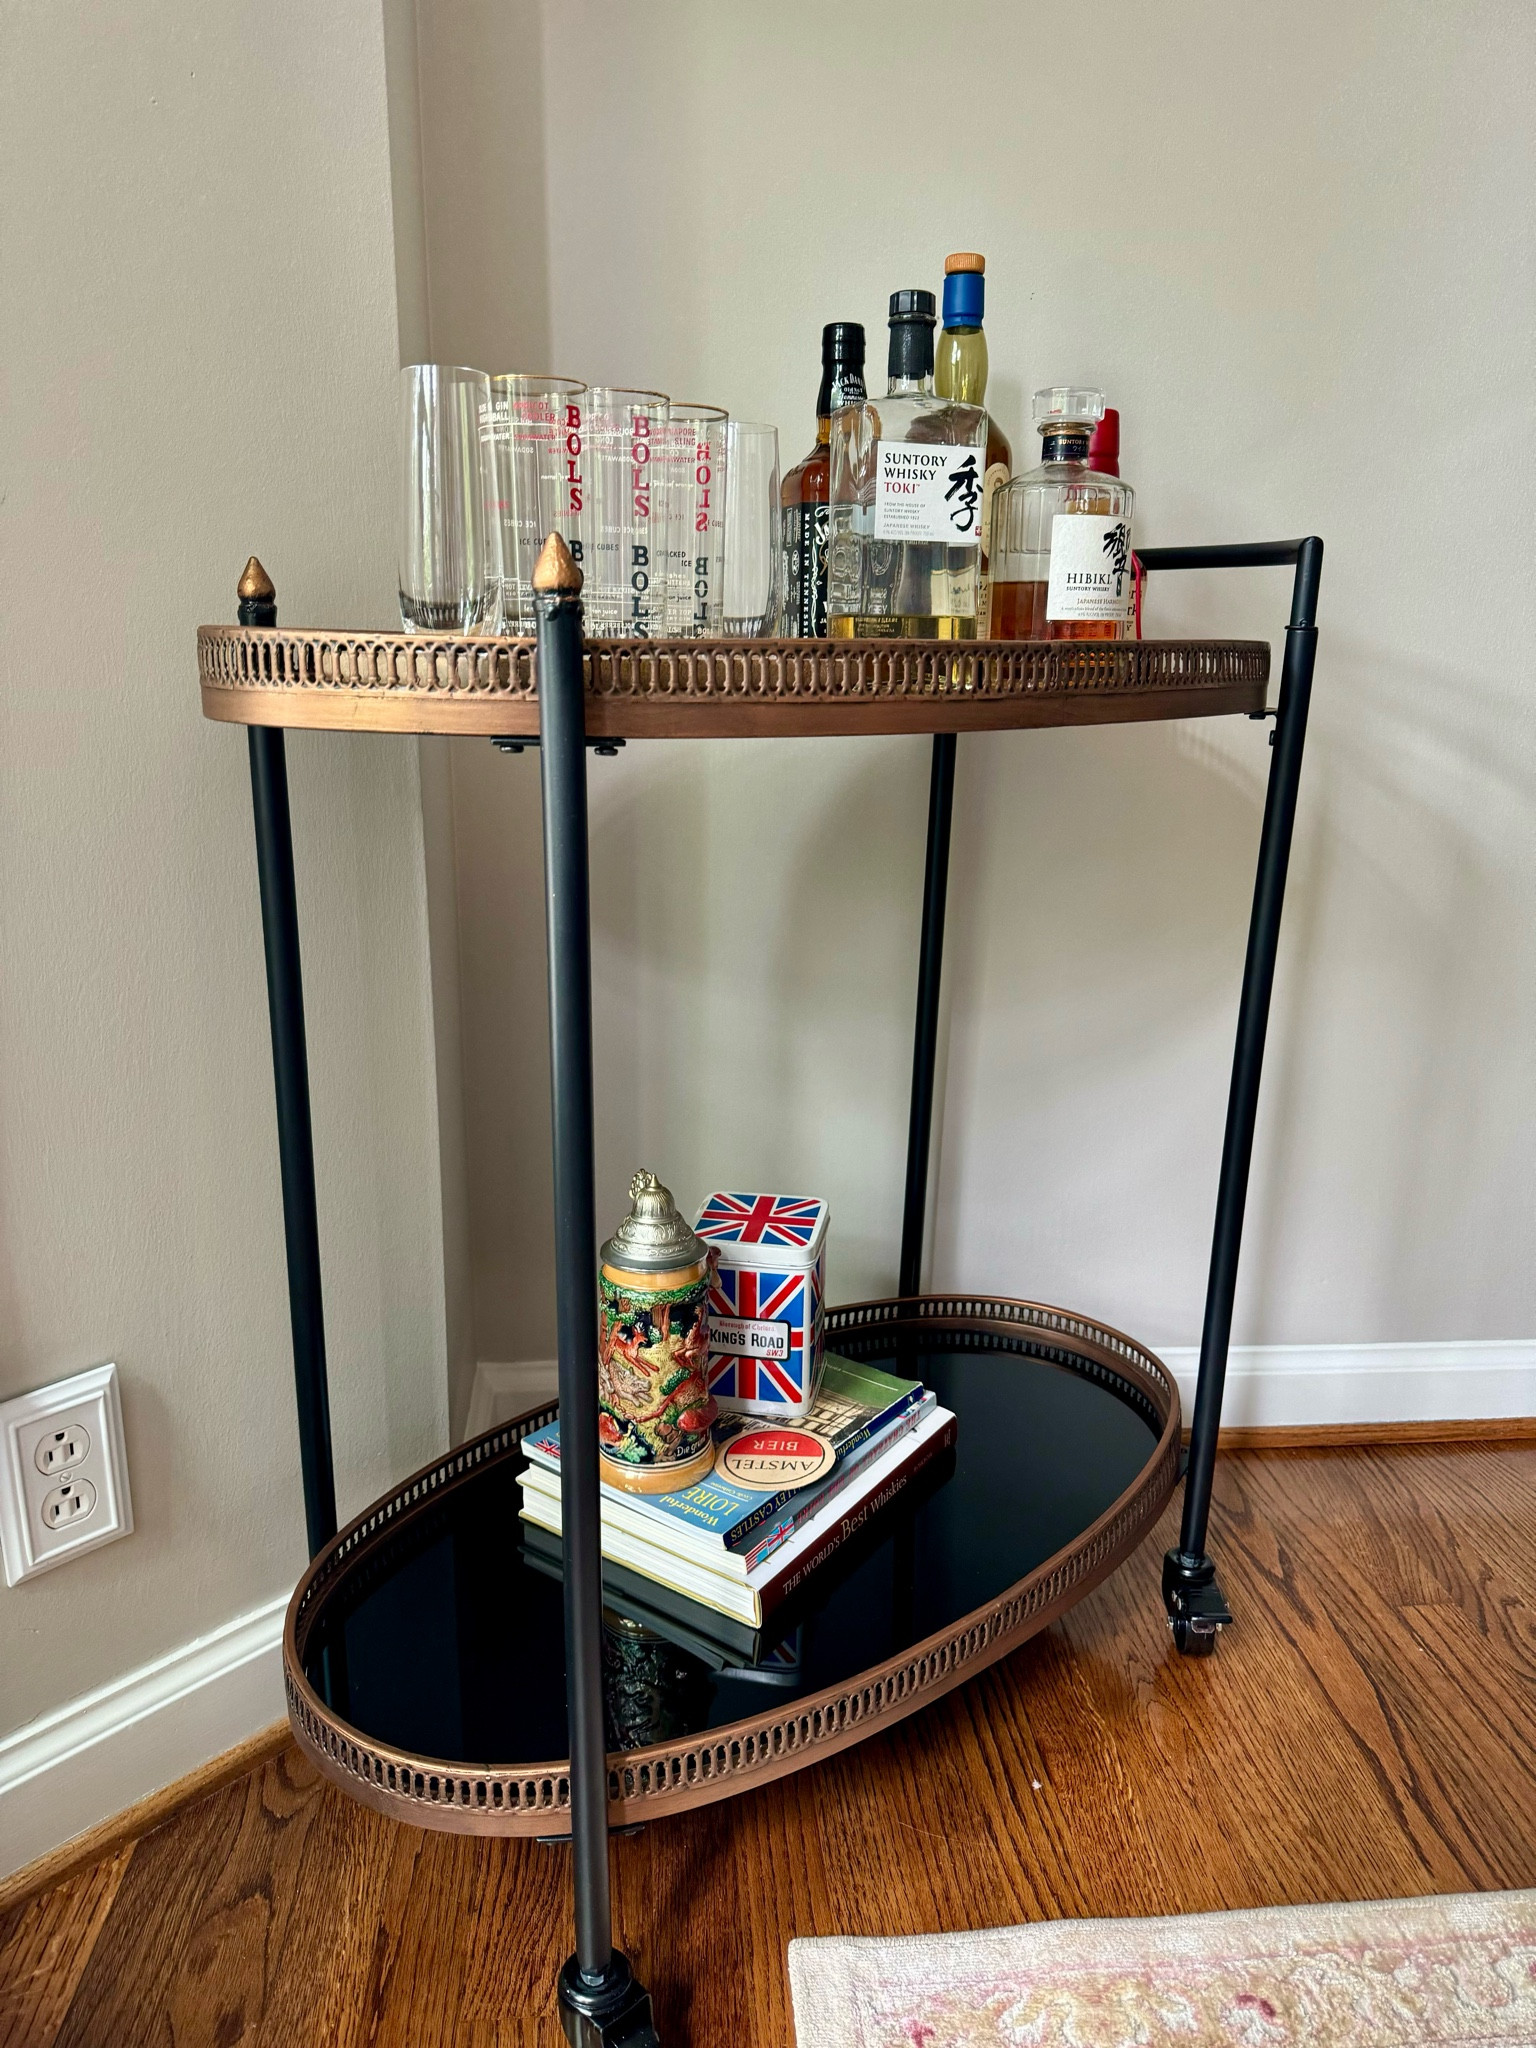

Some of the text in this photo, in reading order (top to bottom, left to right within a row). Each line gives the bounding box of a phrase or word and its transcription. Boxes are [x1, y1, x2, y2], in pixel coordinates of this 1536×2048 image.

[566, 404, 583, 511] BOLS
[632, 415, 650, 518] BOLS
[884, 452, 948, 466] SUNTORY
[884, 467, 937, 481] WHISKY
[804, 513, 812, 547] MADE
[804, 553, 810, 567] IN
[632, 545, 649, 640] BOLS
[710, 1329, 784, 1349] KING'S ROAD
[677, 1445, 690, 1457] Die
[753, 1440, 808, 1451] BIER
[732, 1459, 814, 1471] AMSTEL
[659, 1495, 719, 1527] Wonderful
[682, 1486, 740, 1516] LOIRE
[730, 1502, 773, 1541] CASTLES
[782, 1571, 801, 1595] THE
[870, 1474, 907, 1514] Whiskies
